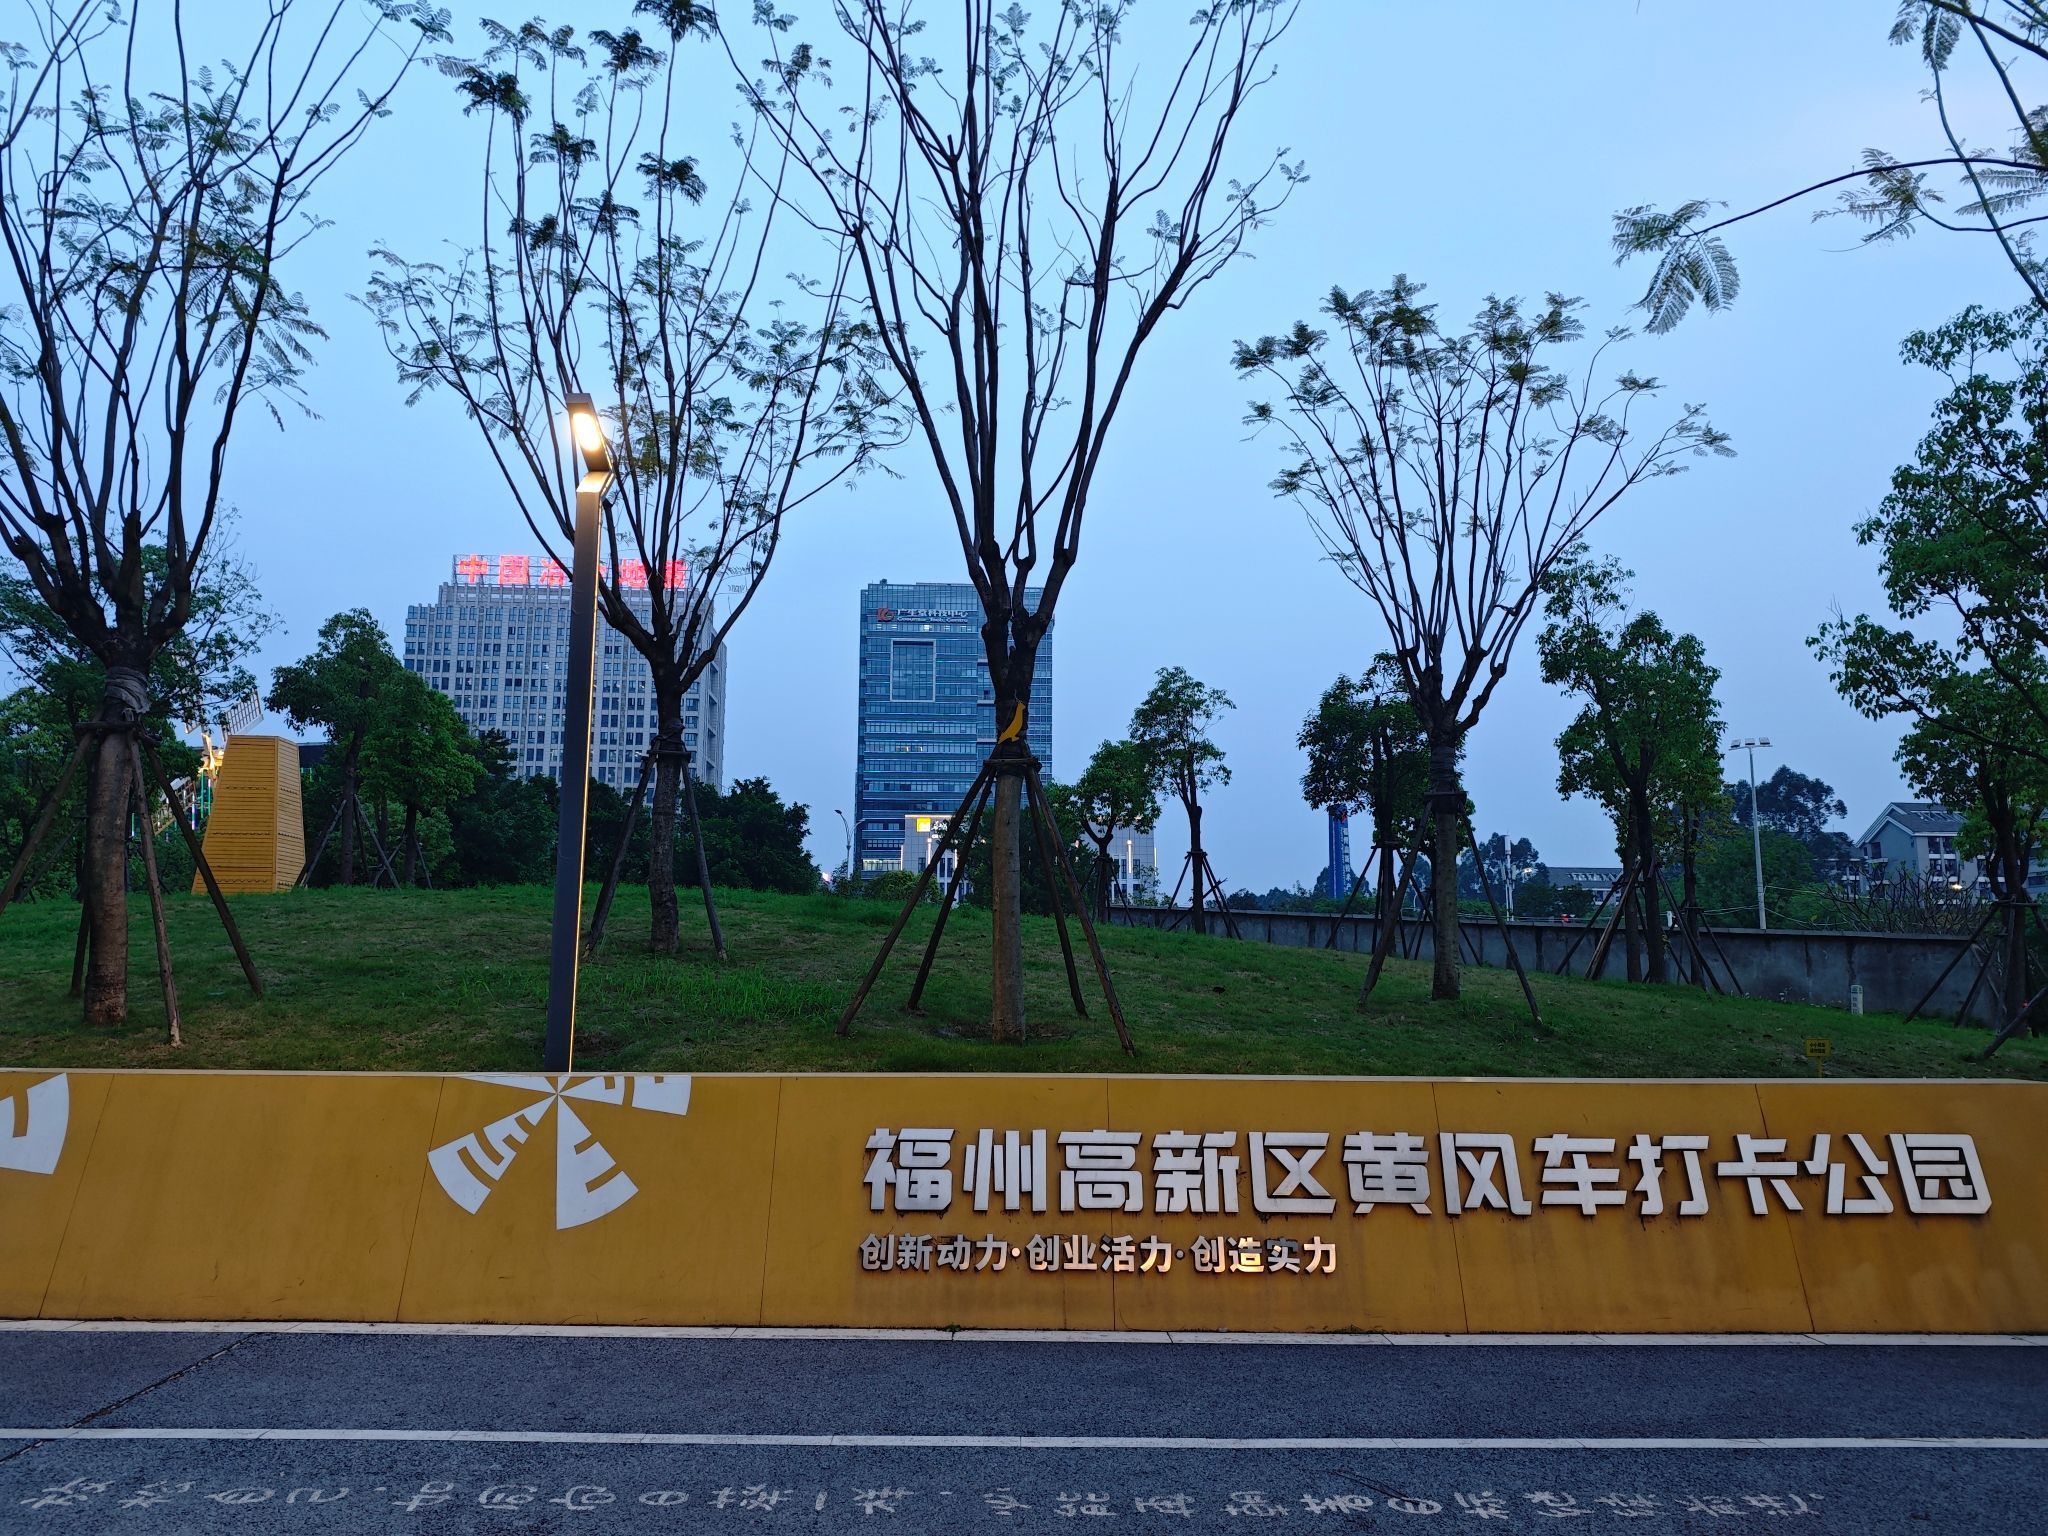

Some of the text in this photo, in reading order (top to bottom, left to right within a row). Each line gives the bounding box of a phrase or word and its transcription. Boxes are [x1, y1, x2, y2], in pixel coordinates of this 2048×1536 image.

[459, 554, 688, 589] 中国冶地质
[863, 1128, 1992, 1219] 福州高新区黄风车打卡公园
[860, 1233, 1338, 1274] 创新动力·创业活力·创造实力
